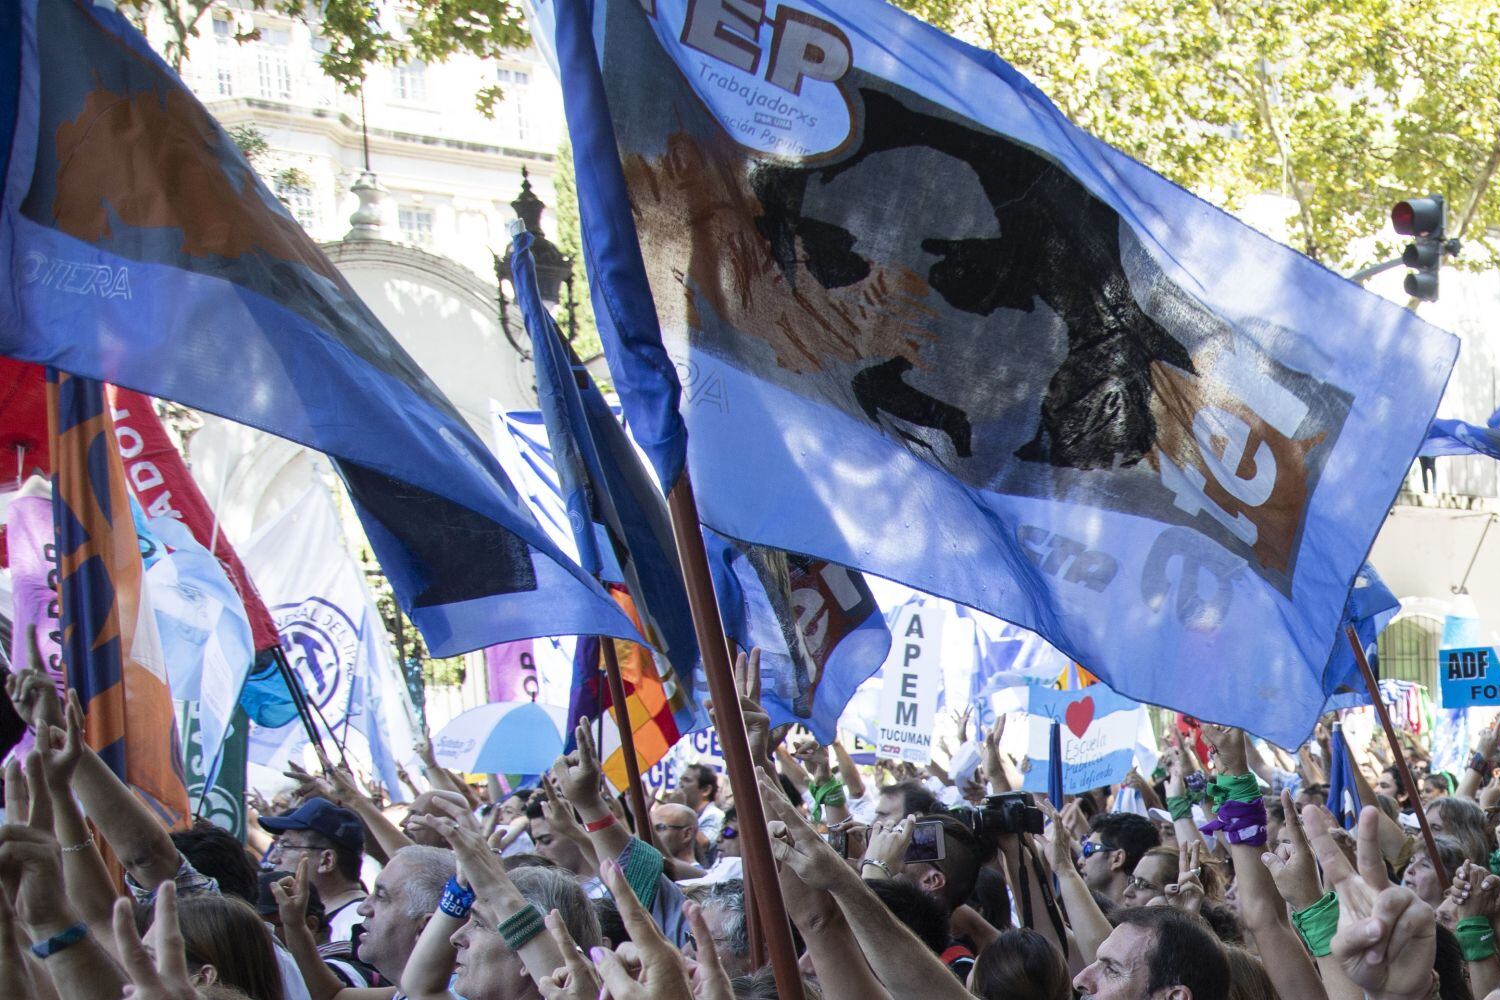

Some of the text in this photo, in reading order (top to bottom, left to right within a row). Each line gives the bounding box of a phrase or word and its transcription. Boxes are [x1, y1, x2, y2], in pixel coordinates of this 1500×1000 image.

[700, 62, 818, 128] Trabajadorxs
[1448, 649, 1489, 680] ADF
[880, 727, 931, 747] TUCUMAN
